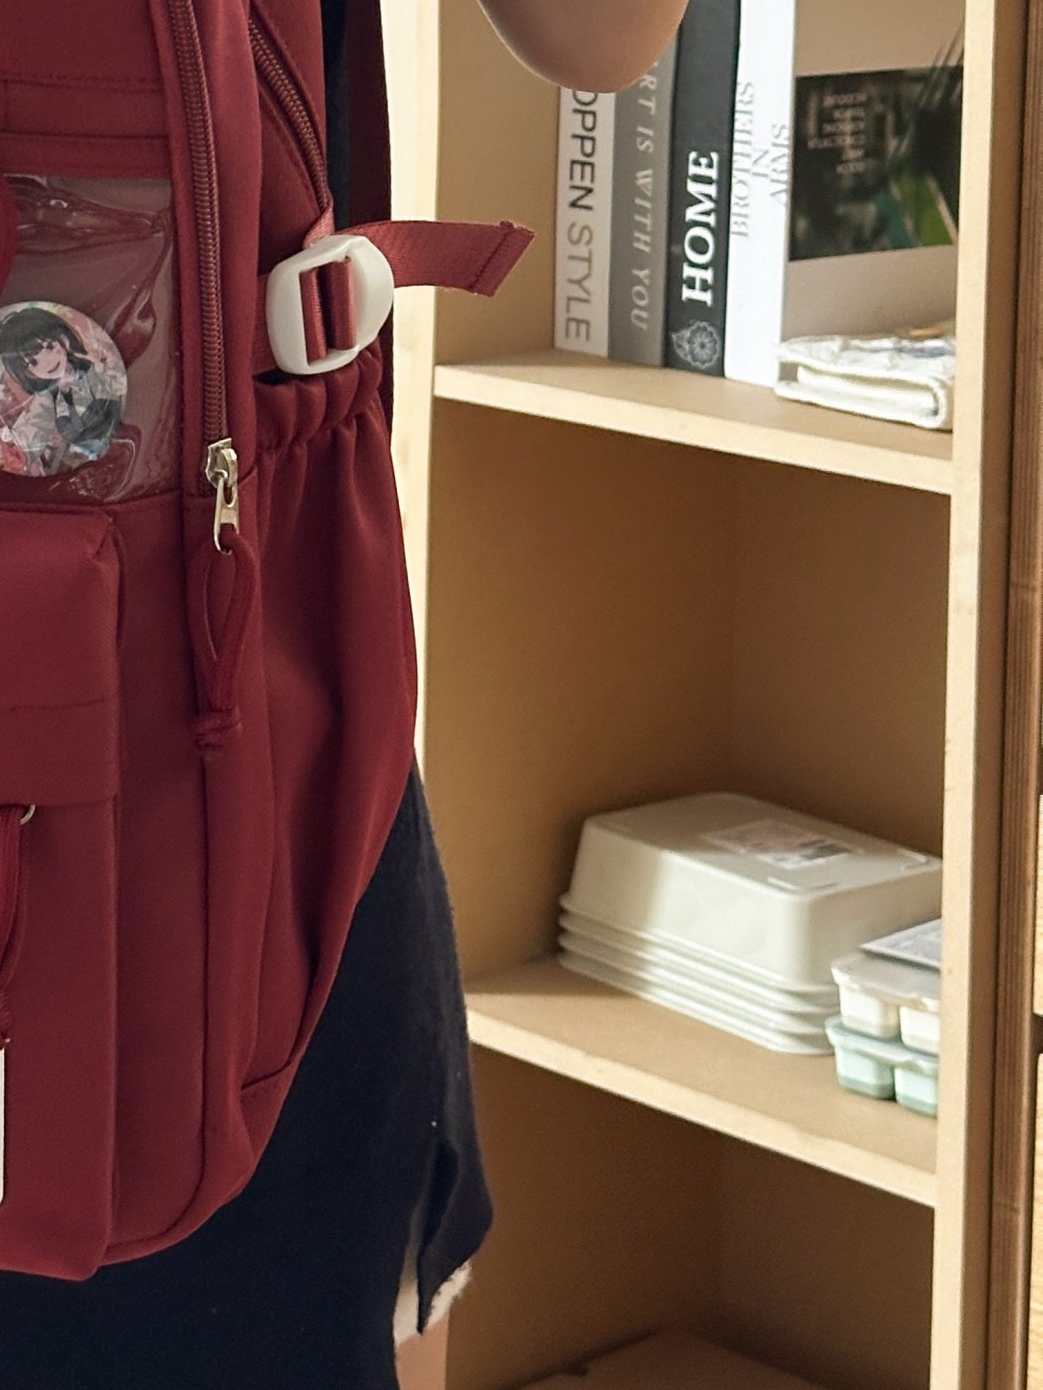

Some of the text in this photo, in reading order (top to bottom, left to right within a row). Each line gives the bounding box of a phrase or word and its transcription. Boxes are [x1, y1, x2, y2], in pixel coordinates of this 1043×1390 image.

[630, 62, 659, 331] RT IS WITH YOU
[681, 150, 719, 307] HOME
[731, 81, 754, 238] BROTHERS
[769, 122, 790, 207] ARMS
[565, 221, 593, 342] STYLE
